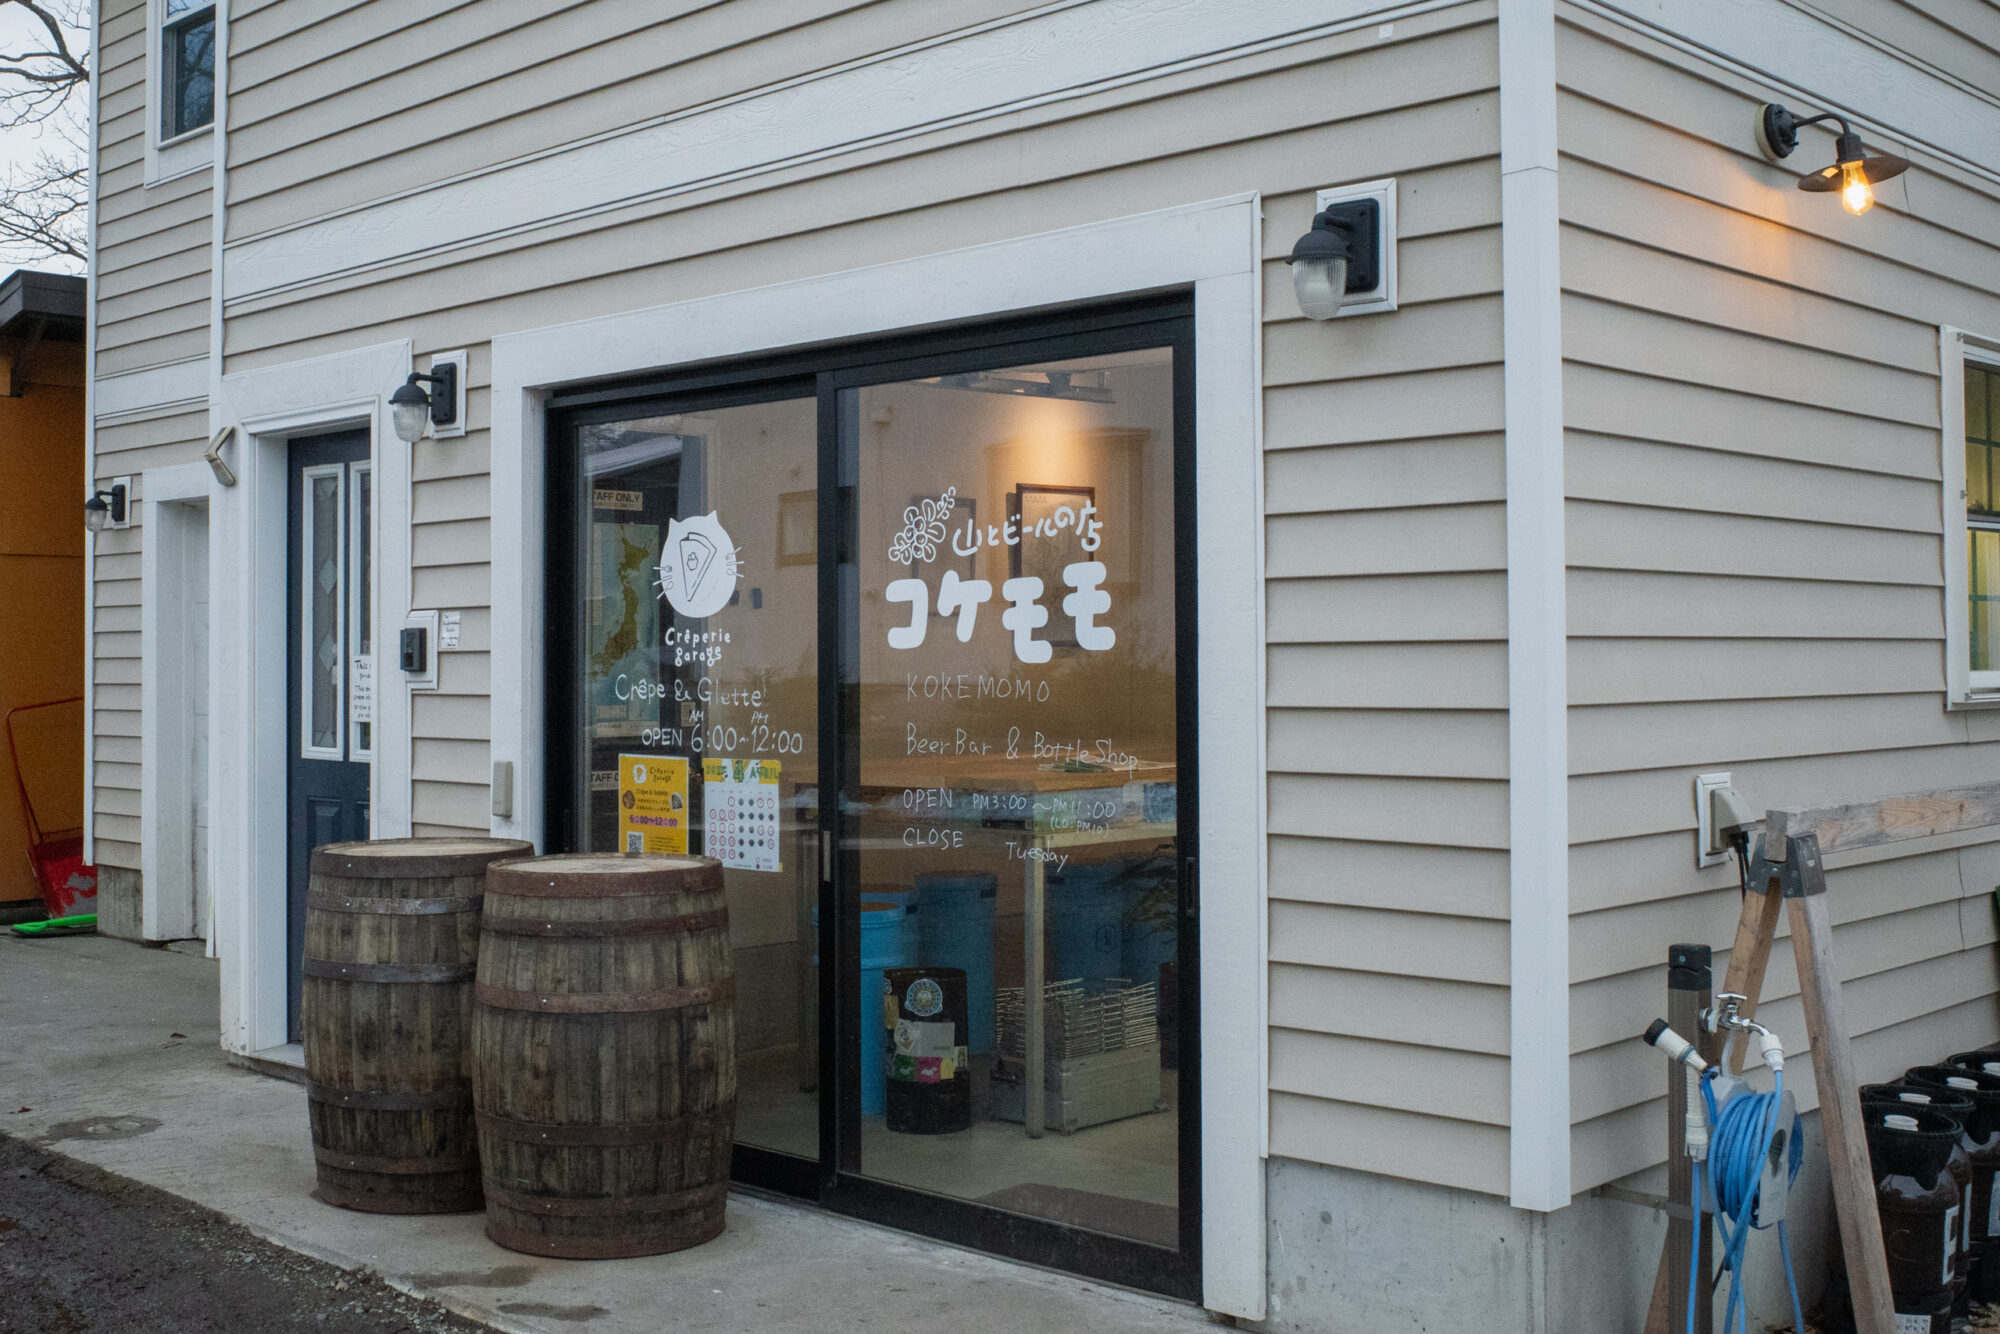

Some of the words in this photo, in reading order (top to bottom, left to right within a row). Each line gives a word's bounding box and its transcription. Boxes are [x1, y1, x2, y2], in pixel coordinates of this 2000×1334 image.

[615, 492, 641, 503] ONLY
[951, 500, 1103, 557] 山とビールの店
[885, 561, 1117, 664] コケモモ
[664, 627, 731, 648] Crêperie
[615, 674, 666, 705] Crêpe
[674, 679, 690, 701] &
[907, 672, 1050, 702] KOKEMOMO
[689, 710, 704, 722] AM
[751, 710, 768, 724] PM
[641, 727, 683, 748] OPEN
[907, 722, 950, 756] Beer
[956, 728, 991, 756] Bar
[1006, 726, 1019, 760] &
[1033, 731, 1089, 768] Bottle
[1095, 738, 1138, 780] Shop
[903, 788, 953, 812] OPEN
[903, 827, 964, 850] CLOSE
[1005, 840, 1069, 872] Tuesday
